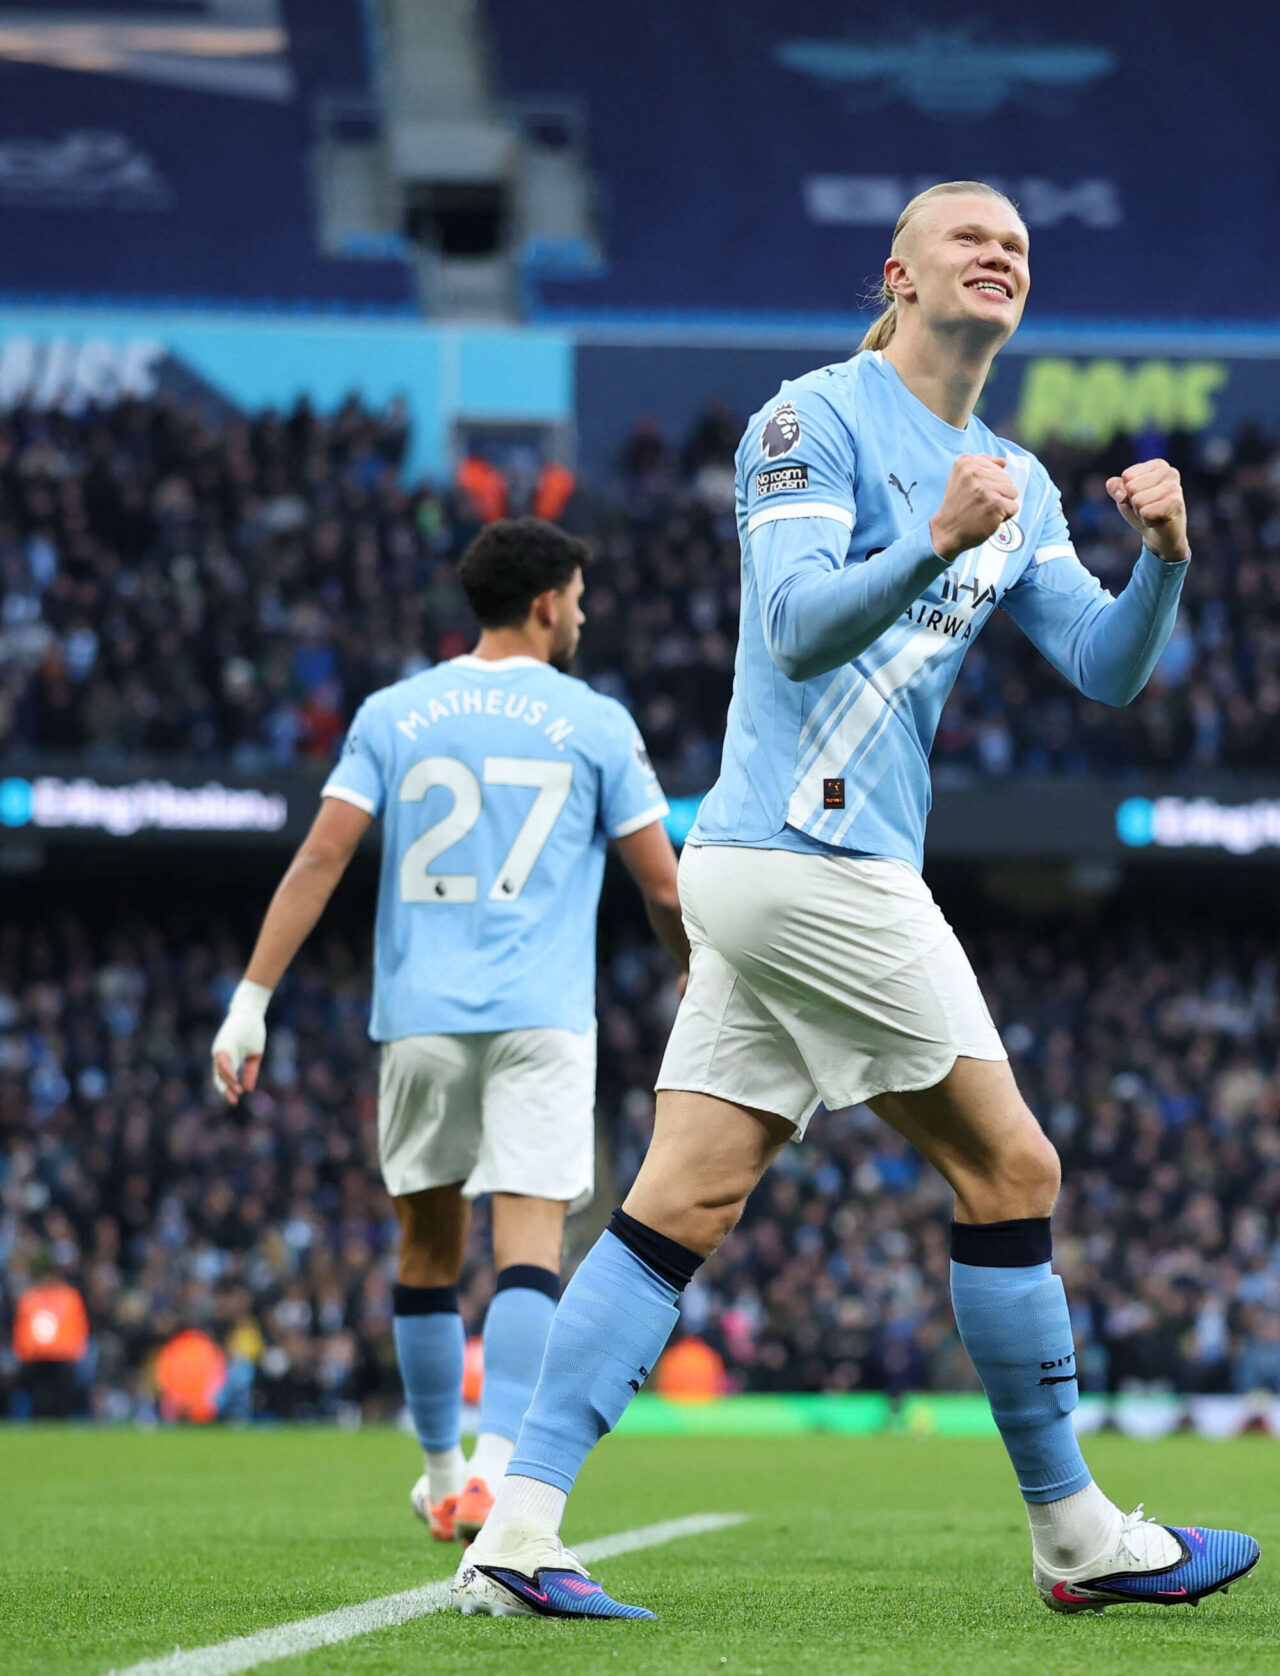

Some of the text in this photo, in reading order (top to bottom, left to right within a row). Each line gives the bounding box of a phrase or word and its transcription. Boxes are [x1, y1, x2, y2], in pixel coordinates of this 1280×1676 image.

[904, 604, 973, 641] AIRWA
[396, 688, 575, 752] MATHEUS N.
[400, 756, 574, 903] 27
